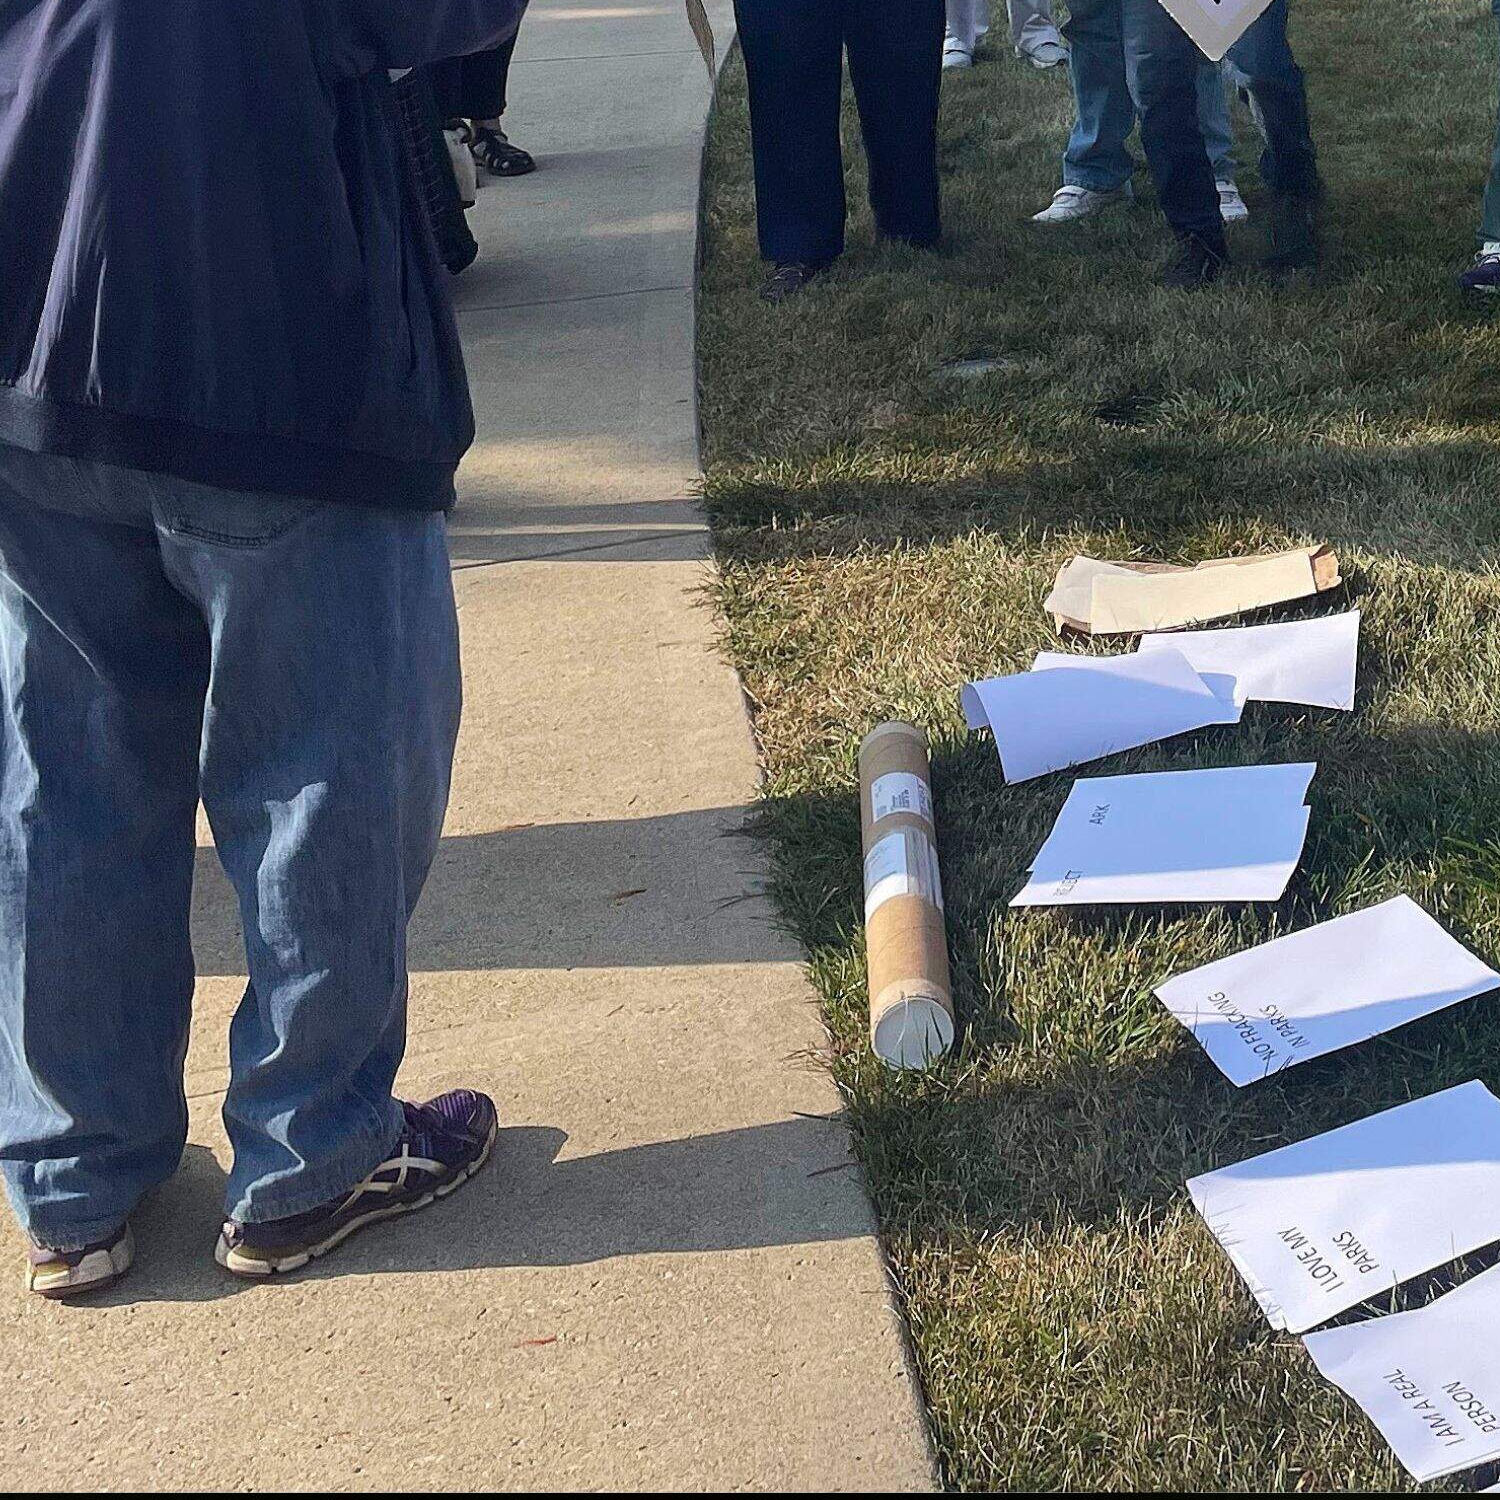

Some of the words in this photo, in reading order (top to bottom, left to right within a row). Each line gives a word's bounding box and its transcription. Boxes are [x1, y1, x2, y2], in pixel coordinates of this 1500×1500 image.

[1259, 1004, 1298, 1038] PARKS
[1277, 1226, 1309, 1250] MY
[1332, 1231, 1380, 1274] PARKS
[1296, 1246, 1338, 1287] LOVE
[1326, 1281, 1344, 1293] I
[1382, 1368, 1425, 1400] REAL
[1413, 1398, 1436, 1410] A
[1422, 1412, 1460, 1437] AM
[1444, 1437, 1466, 1447] I
